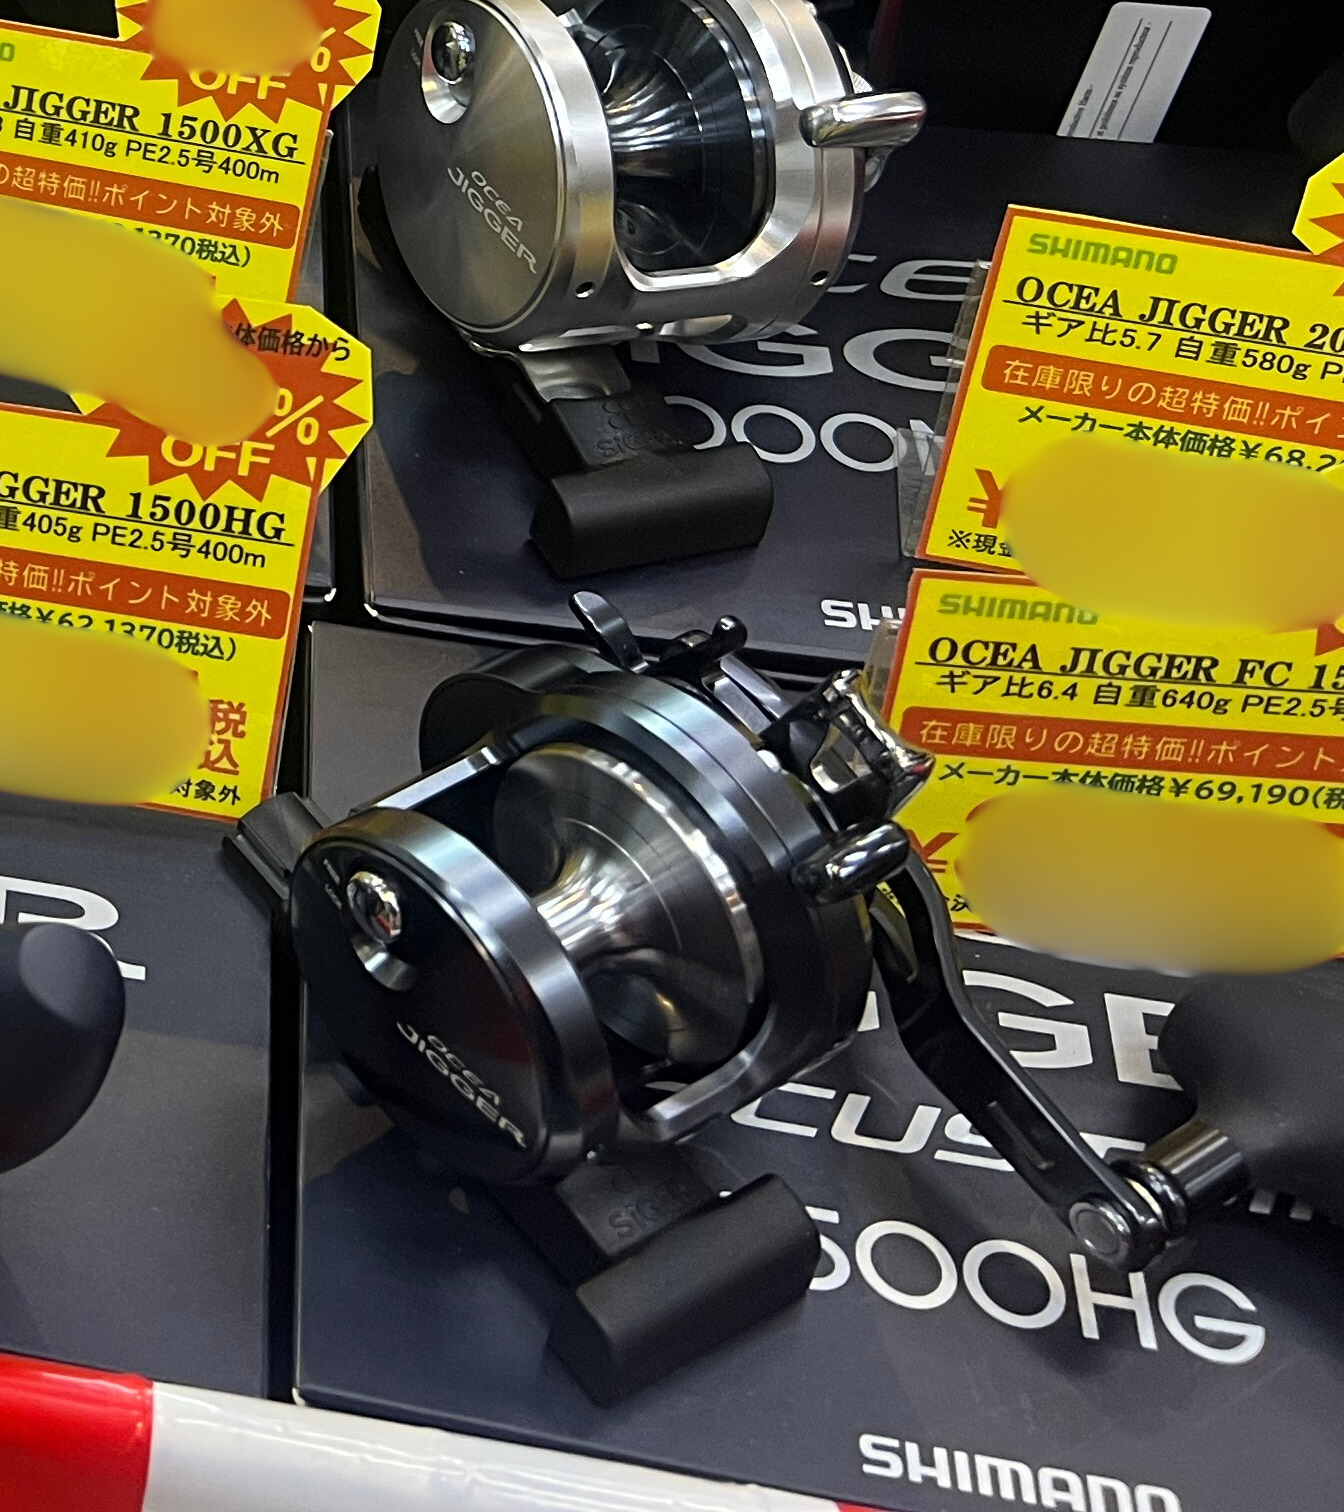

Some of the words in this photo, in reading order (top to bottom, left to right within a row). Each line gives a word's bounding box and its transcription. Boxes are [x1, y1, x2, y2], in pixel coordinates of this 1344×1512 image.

[3, 84, 140, 133] JIGGER
[160, 113, 299, 159] 1500XG
[14, 118, 118, 157] 自重410g
[125, 141, 280, 184] PE2.5号400m
[448, 168, 537, 274] JIGGER
[471, 171, 523, 231] OCEA
[1027, 233, 1178, 275] SHIMANO
[1015, 276, 1122, 319] OCEA
[1139, 296, 1291, 345] JIGGER
[1021, 311, 1161, 352] ギア比5.7
[1174, 336, 1311, 381] 自重580g
[92, 523, 266, 567] PE2.5号400m
[131, 493, 286, 540] 1500HG
[928, 637, 1042, 669] OCEA
[1060, 647, 1219, 683] JIGGER
[1232, 659, 1292, 687] FC
[935, 672, 1078, 700] ギア比6.4
[1094, 686, 1231, 715] 自重640g
[395, 1020, 529, 1150] JIGGER
